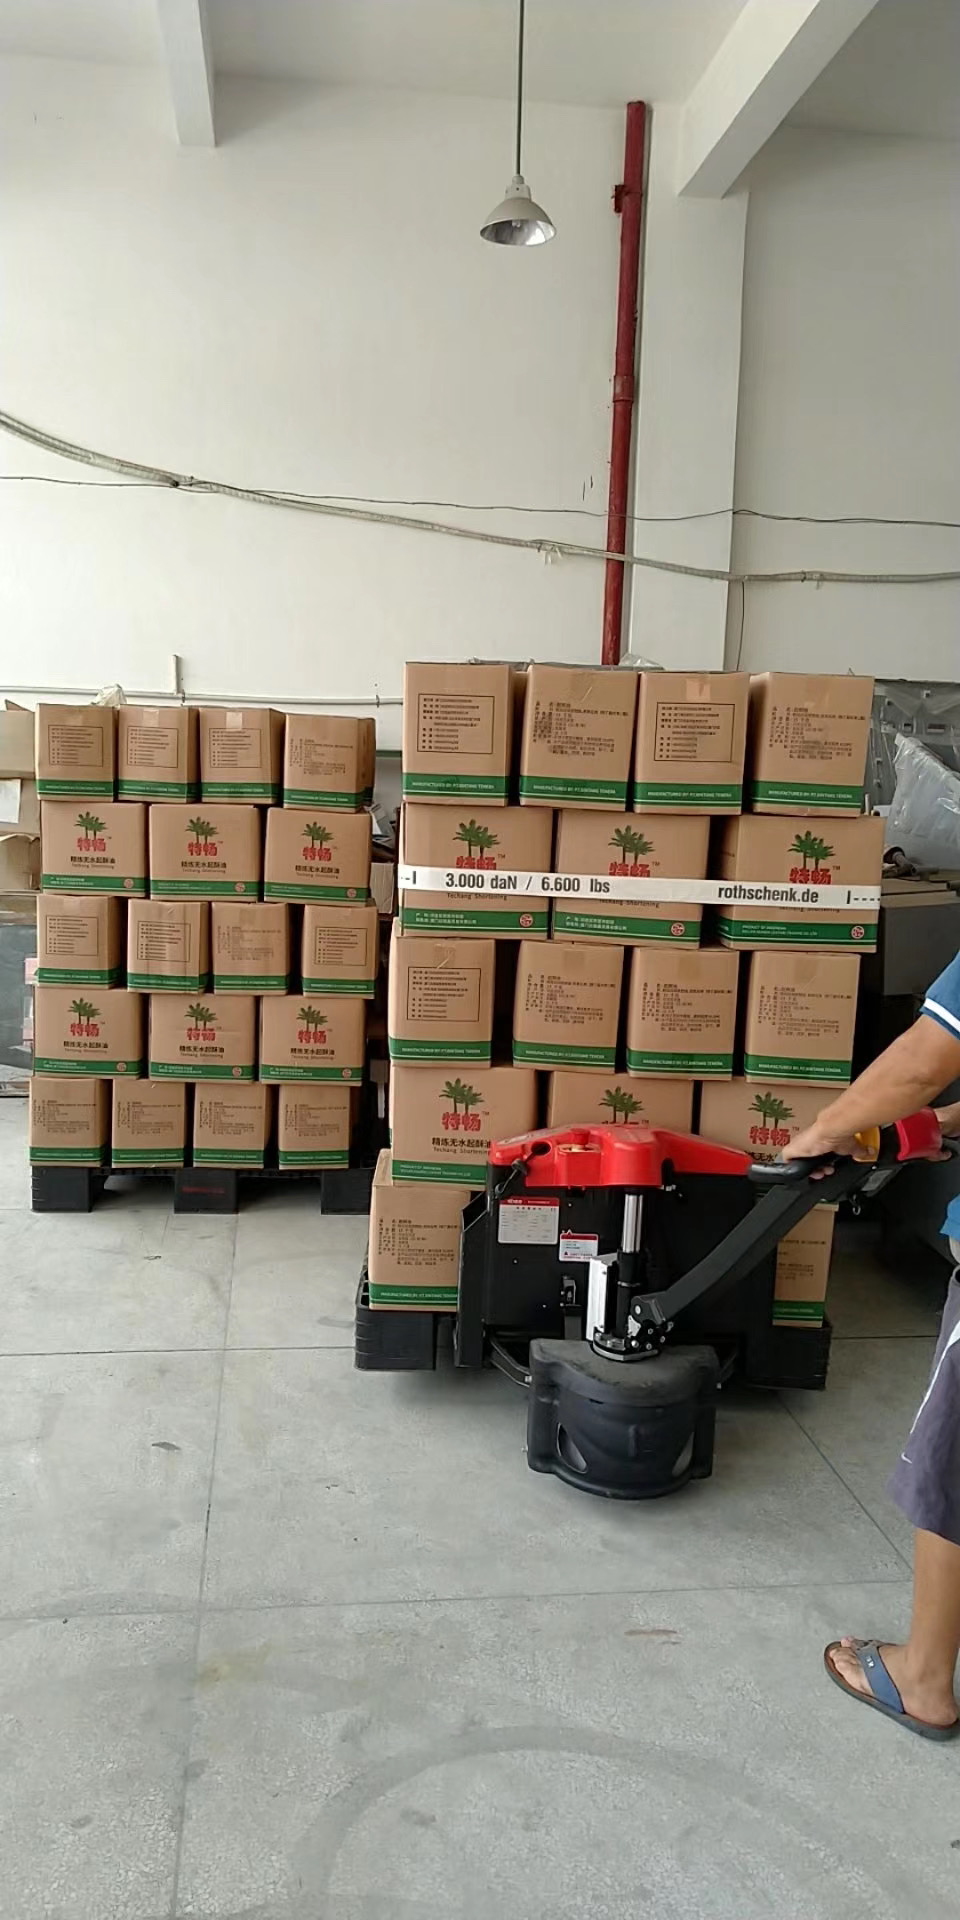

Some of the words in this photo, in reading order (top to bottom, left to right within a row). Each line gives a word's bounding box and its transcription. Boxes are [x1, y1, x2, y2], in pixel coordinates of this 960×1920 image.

[446, 872, 485, 889] 3.000
[490, 875, 517, 890] daN
[525, 876, 533, 890] /
[541, 876, 580, 892] 6.600
[590, 878, 610, 893] lbs
[718, 885, 819, 903] rothschenk.de
[442, 1112, 481, 1132] 特畅
[749, 1125, 791, 1146] 特畅
